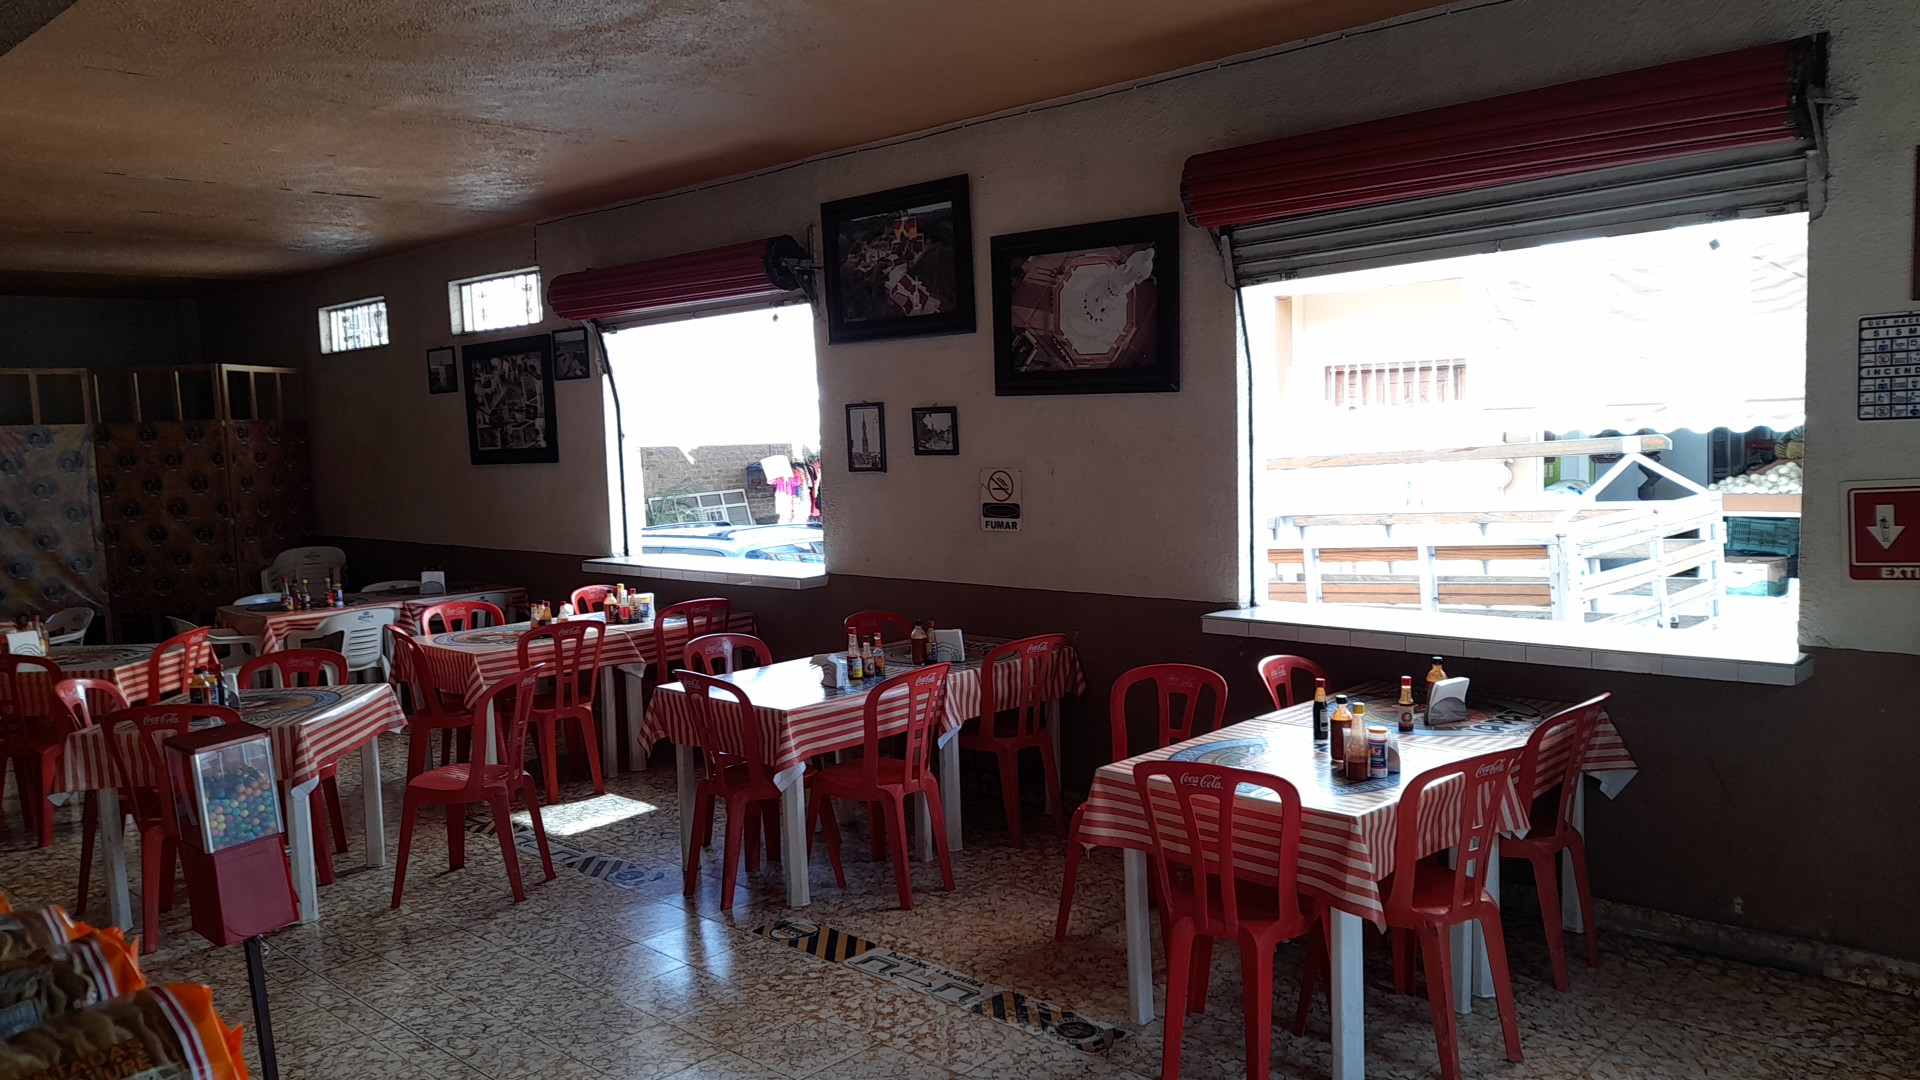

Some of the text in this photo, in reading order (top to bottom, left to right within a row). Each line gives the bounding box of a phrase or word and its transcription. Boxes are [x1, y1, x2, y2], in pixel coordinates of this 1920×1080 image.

[985, 520, 1018, 531] FUMAR
[143, 713, 180, 725] Coca-Cola
[1180, 772, 1224, 790] Coca-Cola
